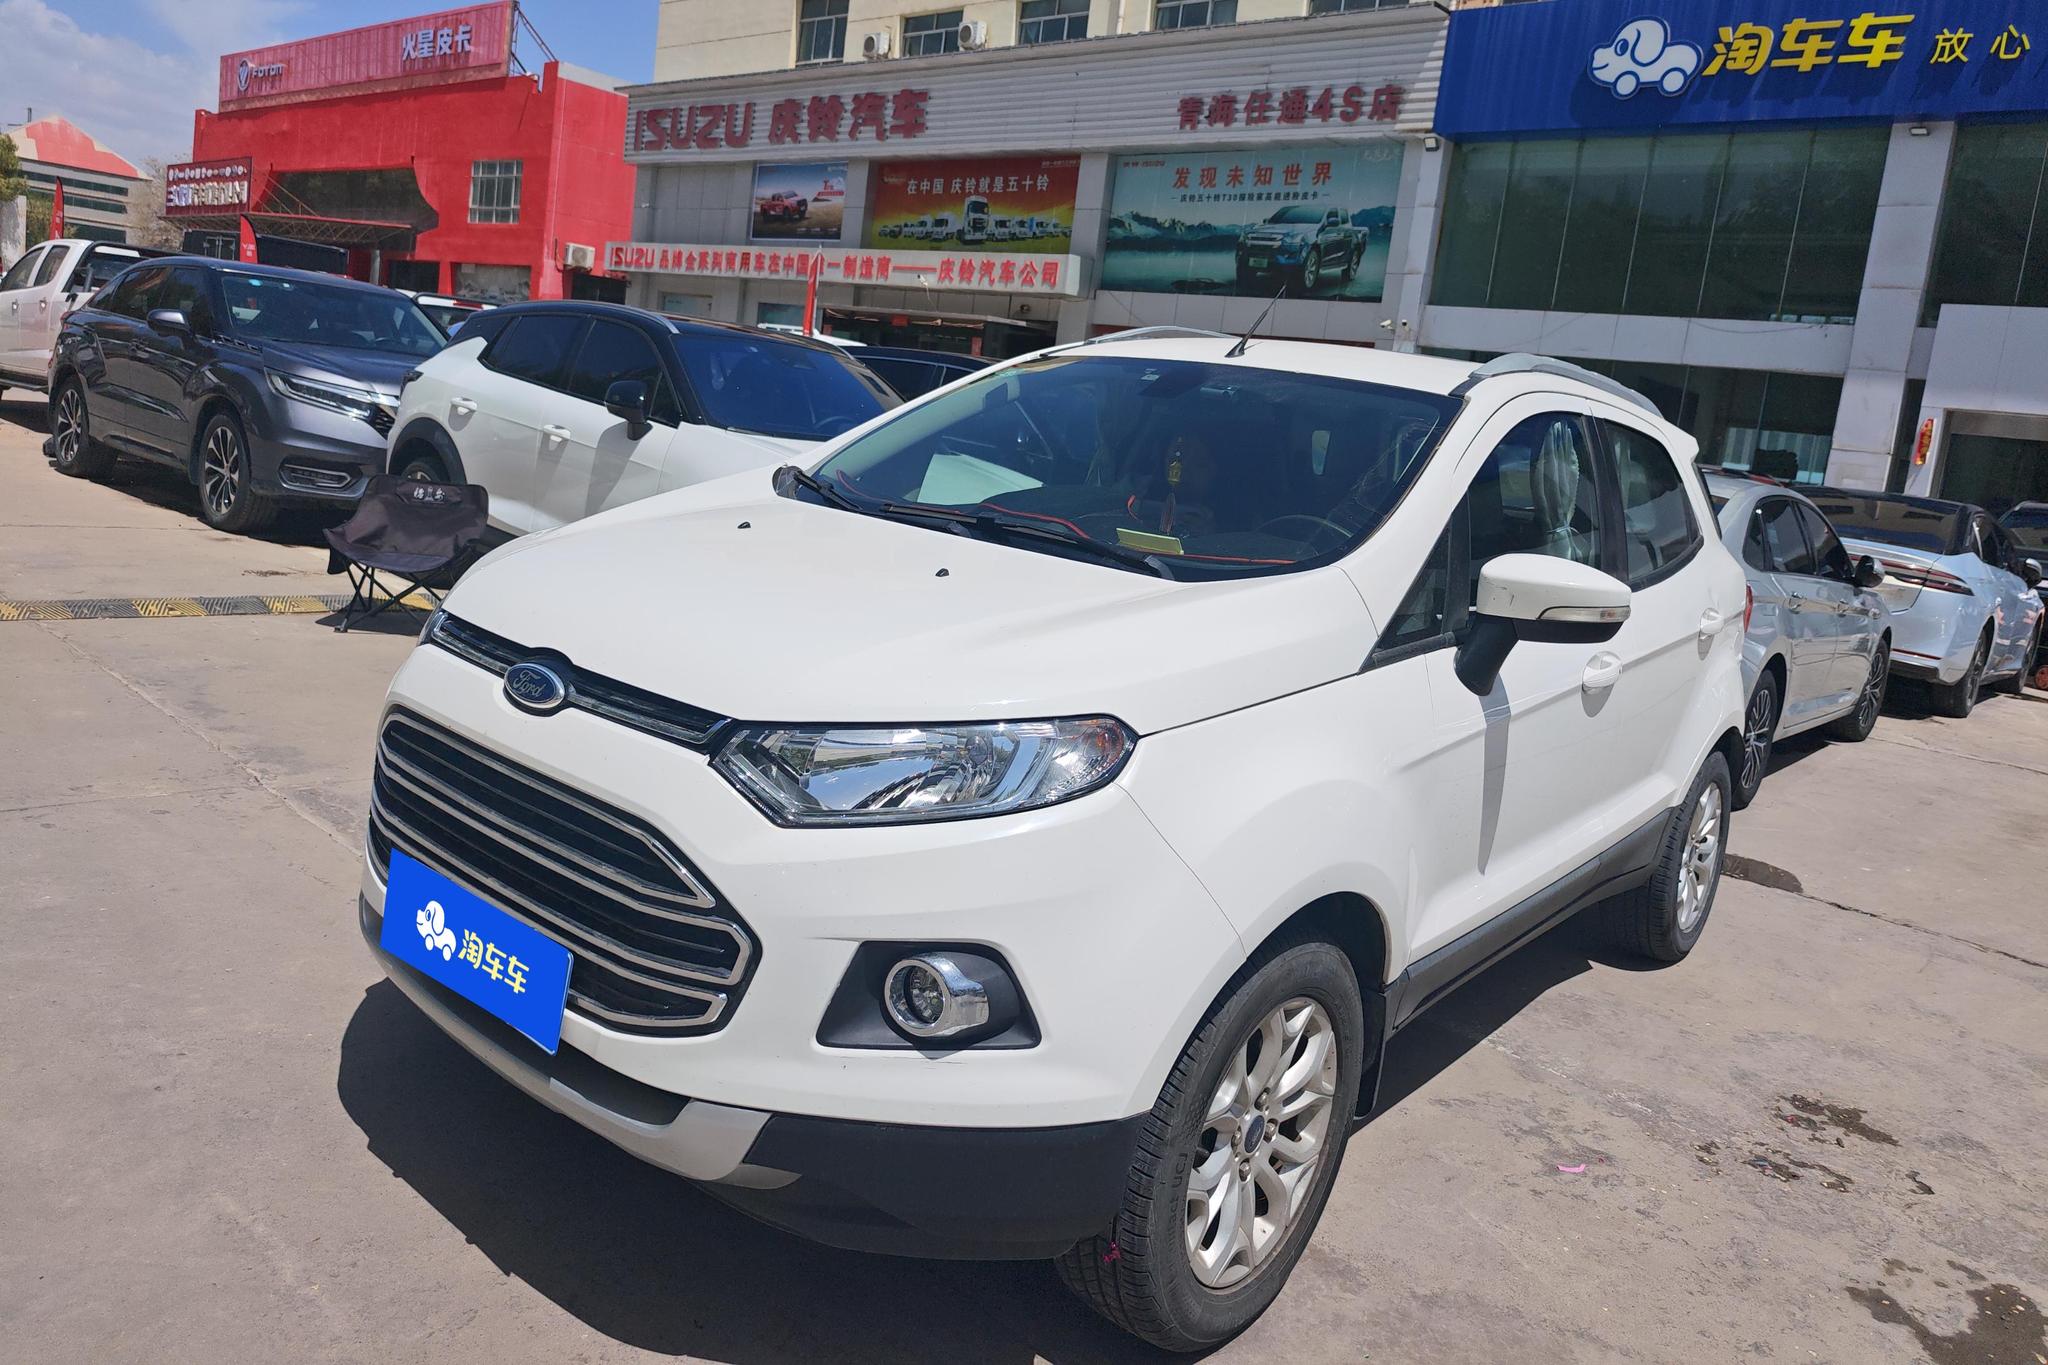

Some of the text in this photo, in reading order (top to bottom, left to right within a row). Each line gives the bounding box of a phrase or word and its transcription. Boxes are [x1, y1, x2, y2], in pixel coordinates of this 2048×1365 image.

[402, 25, 472, 60] 火星皮卡
[1701, 12, 2031, 76] 淘车车 放心
[634, 89, 930, 151] ISUZU 庆铃汽车
[1177, 84, 1402, 131] 青海任通4S店
[906, 177, 944, 195] 在中国
[950, 174, 1050, 194] 庆铃就是五十铃
[1172, 162, 1334, 189] 发现未知世界
[609, 247, 655, 268] ISUZU
[511, 669, 547, 697] Ford
